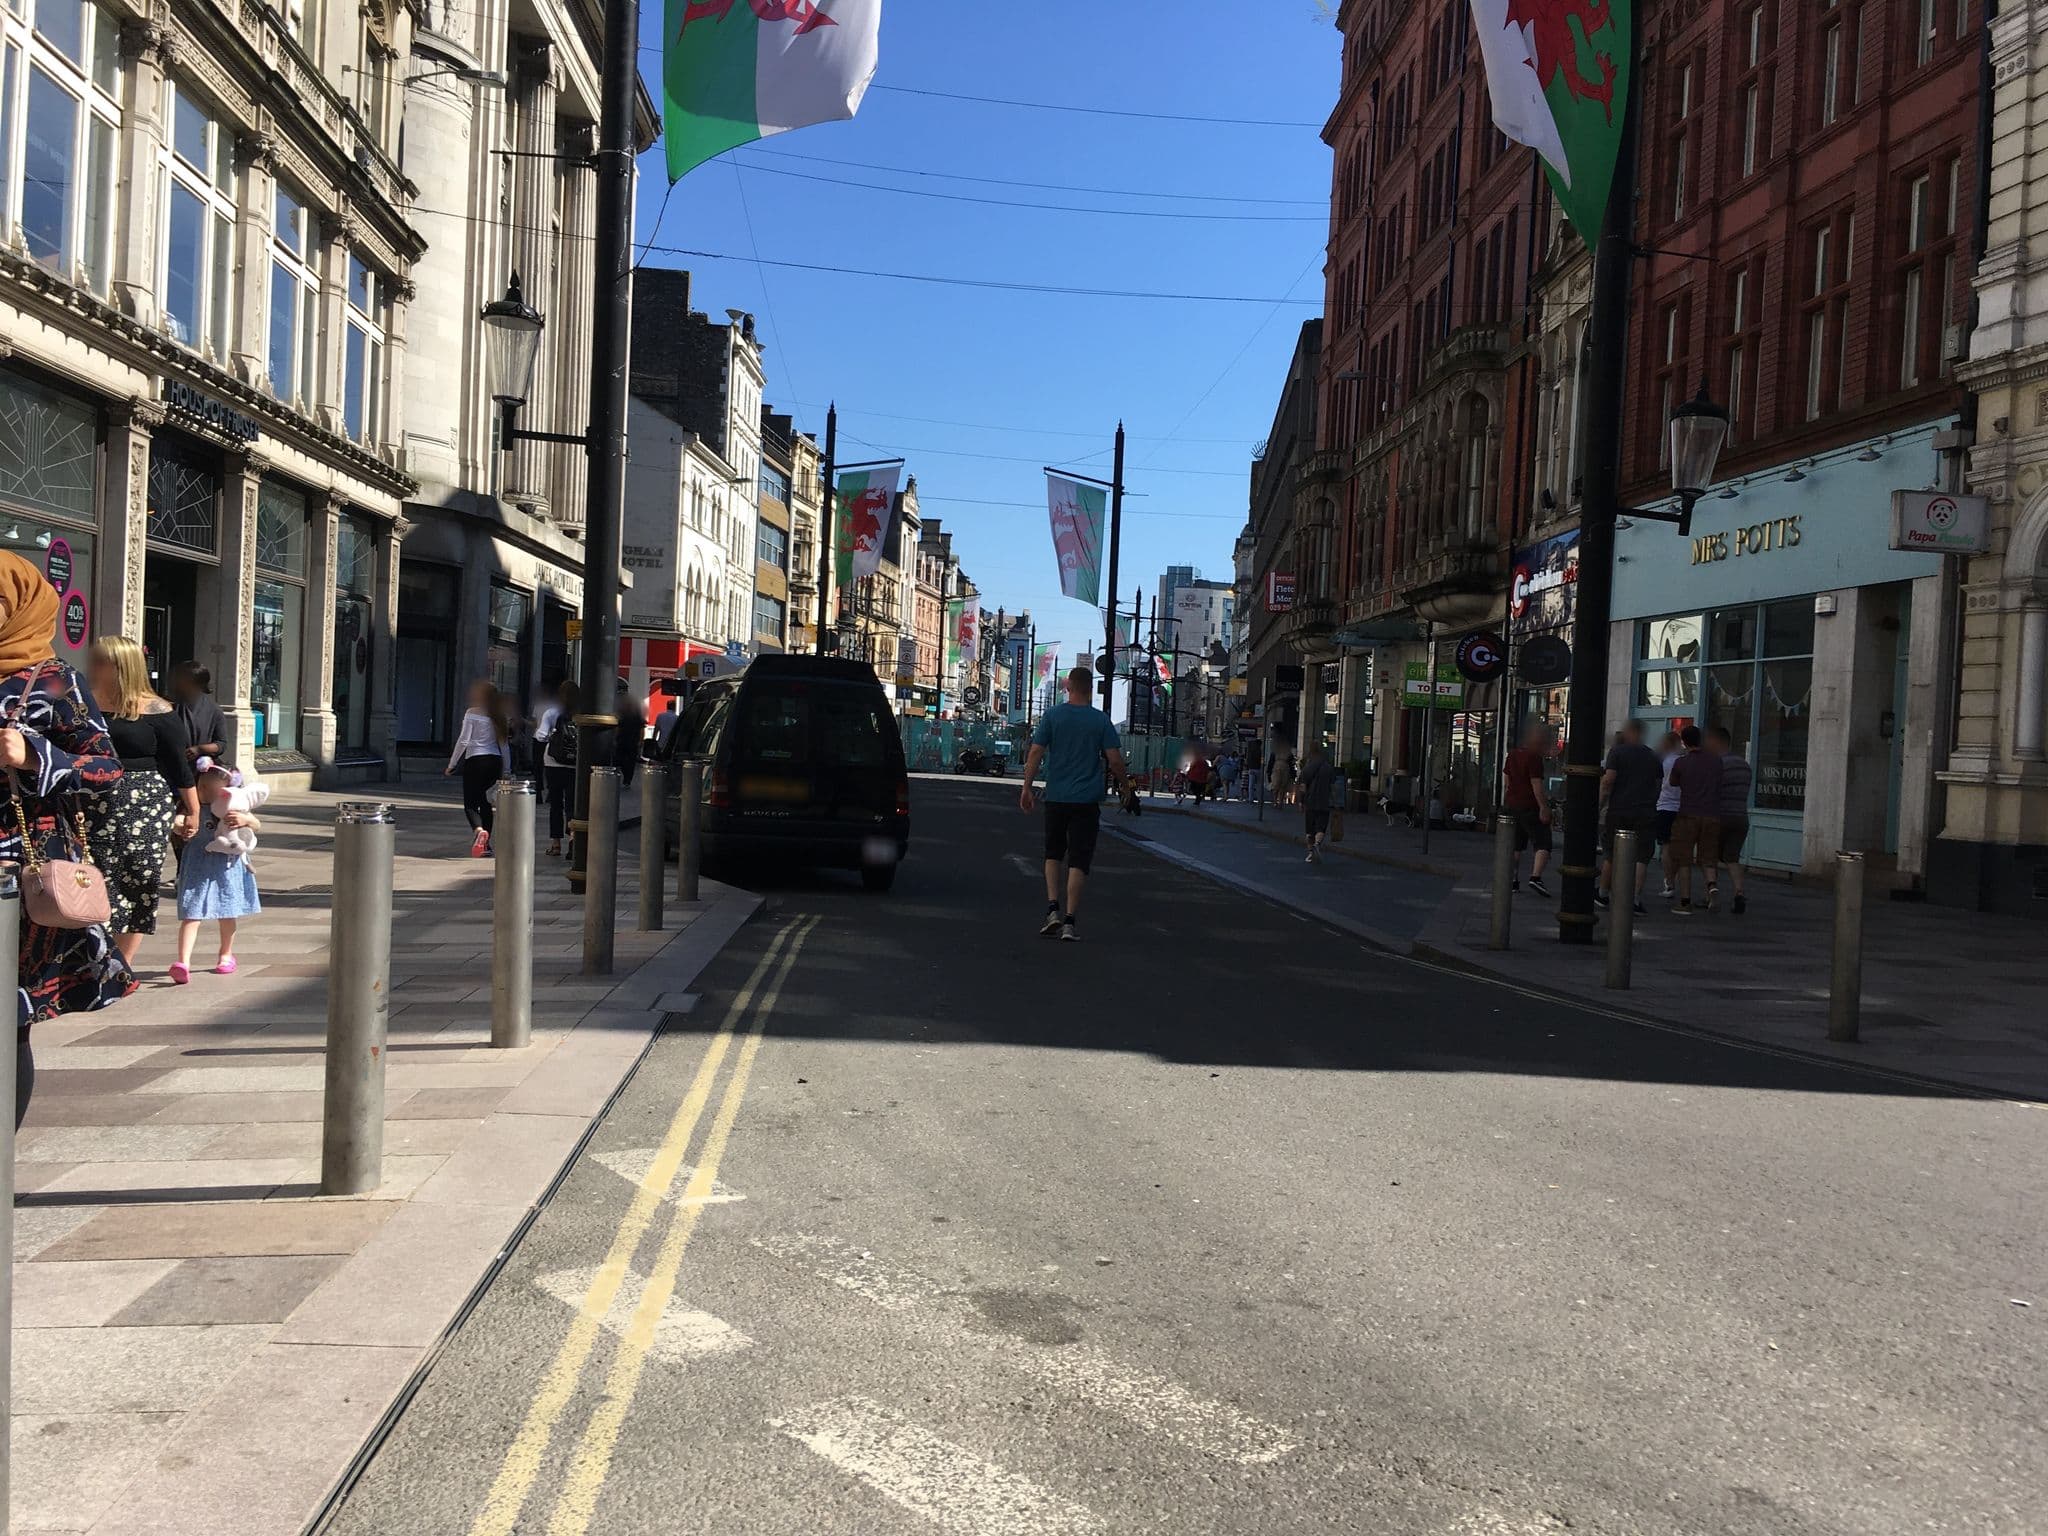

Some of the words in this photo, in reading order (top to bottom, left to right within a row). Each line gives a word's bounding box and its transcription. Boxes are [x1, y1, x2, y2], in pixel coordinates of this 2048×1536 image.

[171, 380, 209, 418] HOUSE
[210, 398, 225, 425] OF
[226, 407, 260, 442] FRASER
[1691, 531, 1729, 566] MRS
[1735, 515, 1802, 557] POTTS
[1908, 529, 1937, 544] Papa
[534, 562, 552, 585] JAMES
[553, 570, 574, 594] HOWELL
[1417, 684, 1431, 692] TO
[1761, 767, 1780, 778] MRS
